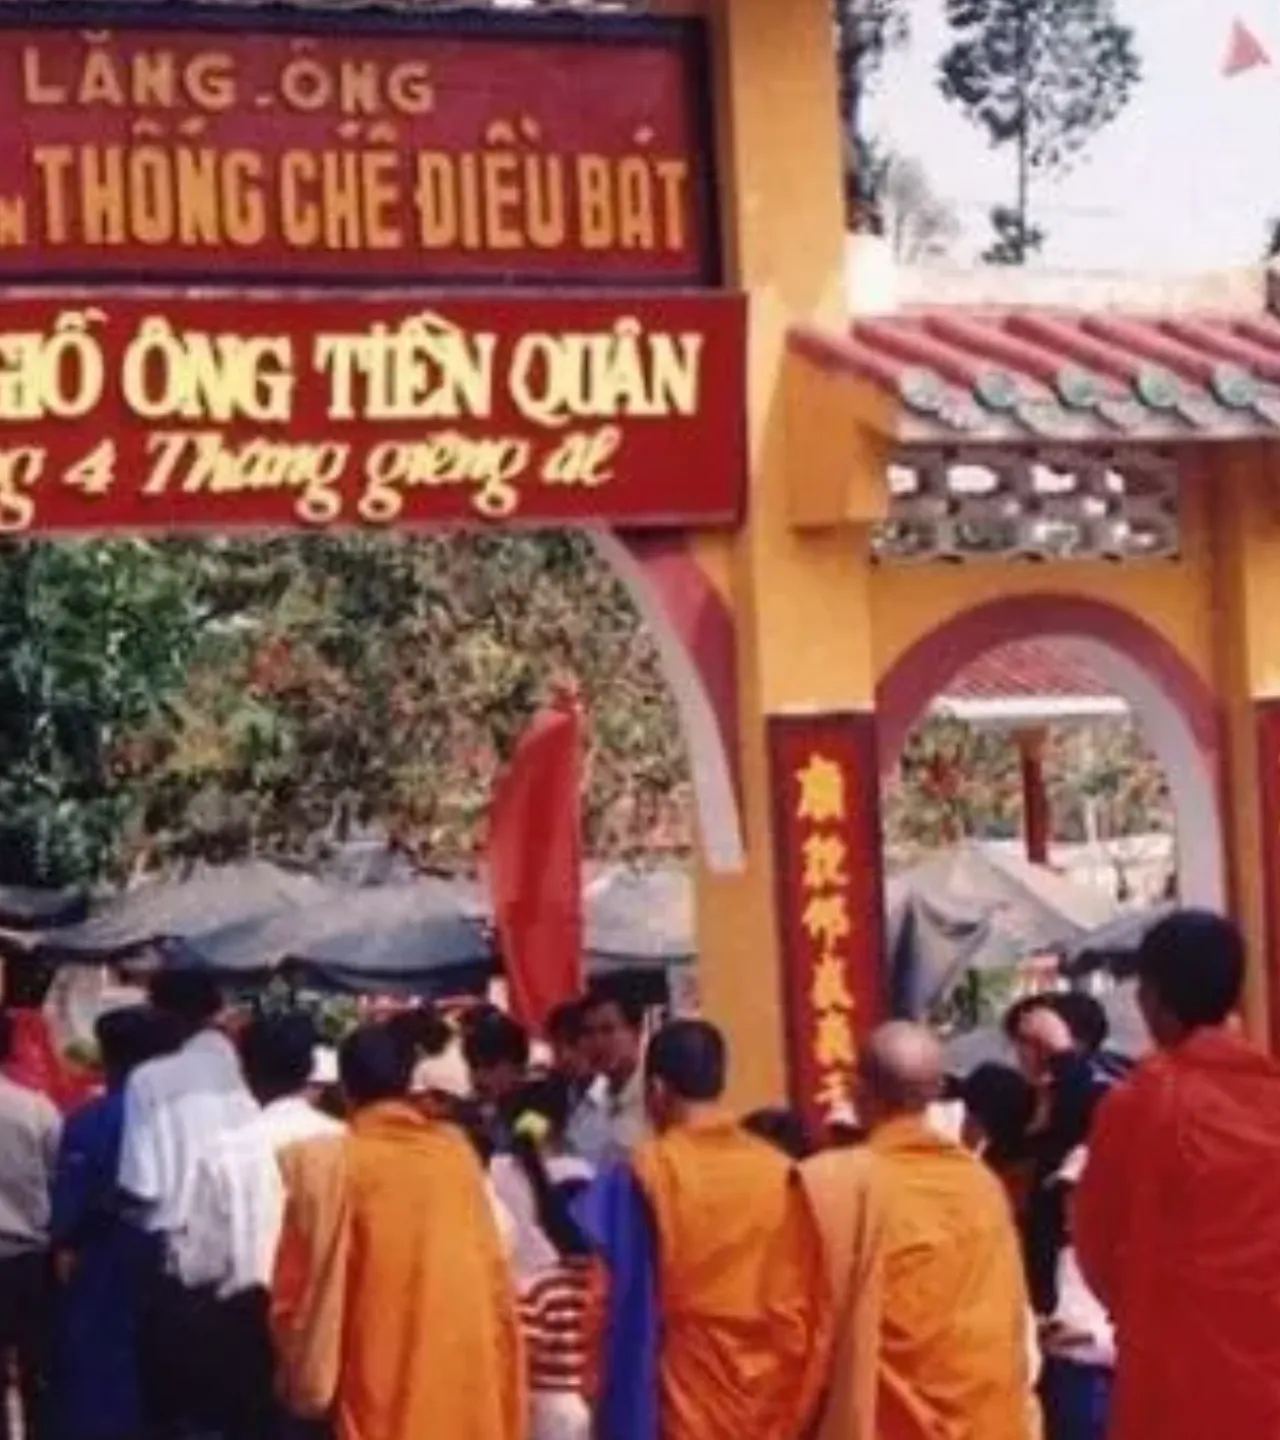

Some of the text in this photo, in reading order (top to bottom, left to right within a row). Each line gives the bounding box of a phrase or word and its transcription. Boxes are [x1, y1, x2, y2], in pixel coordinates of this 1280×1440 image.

[32, 116, 266, 246] THỐNG
[413, 119, 566, 251] ĐIỀU
[122, 315, 295, 421] ÔNG
[508, 315, 704, 427] QUÂN
[61, 437, 118, 493] 4
